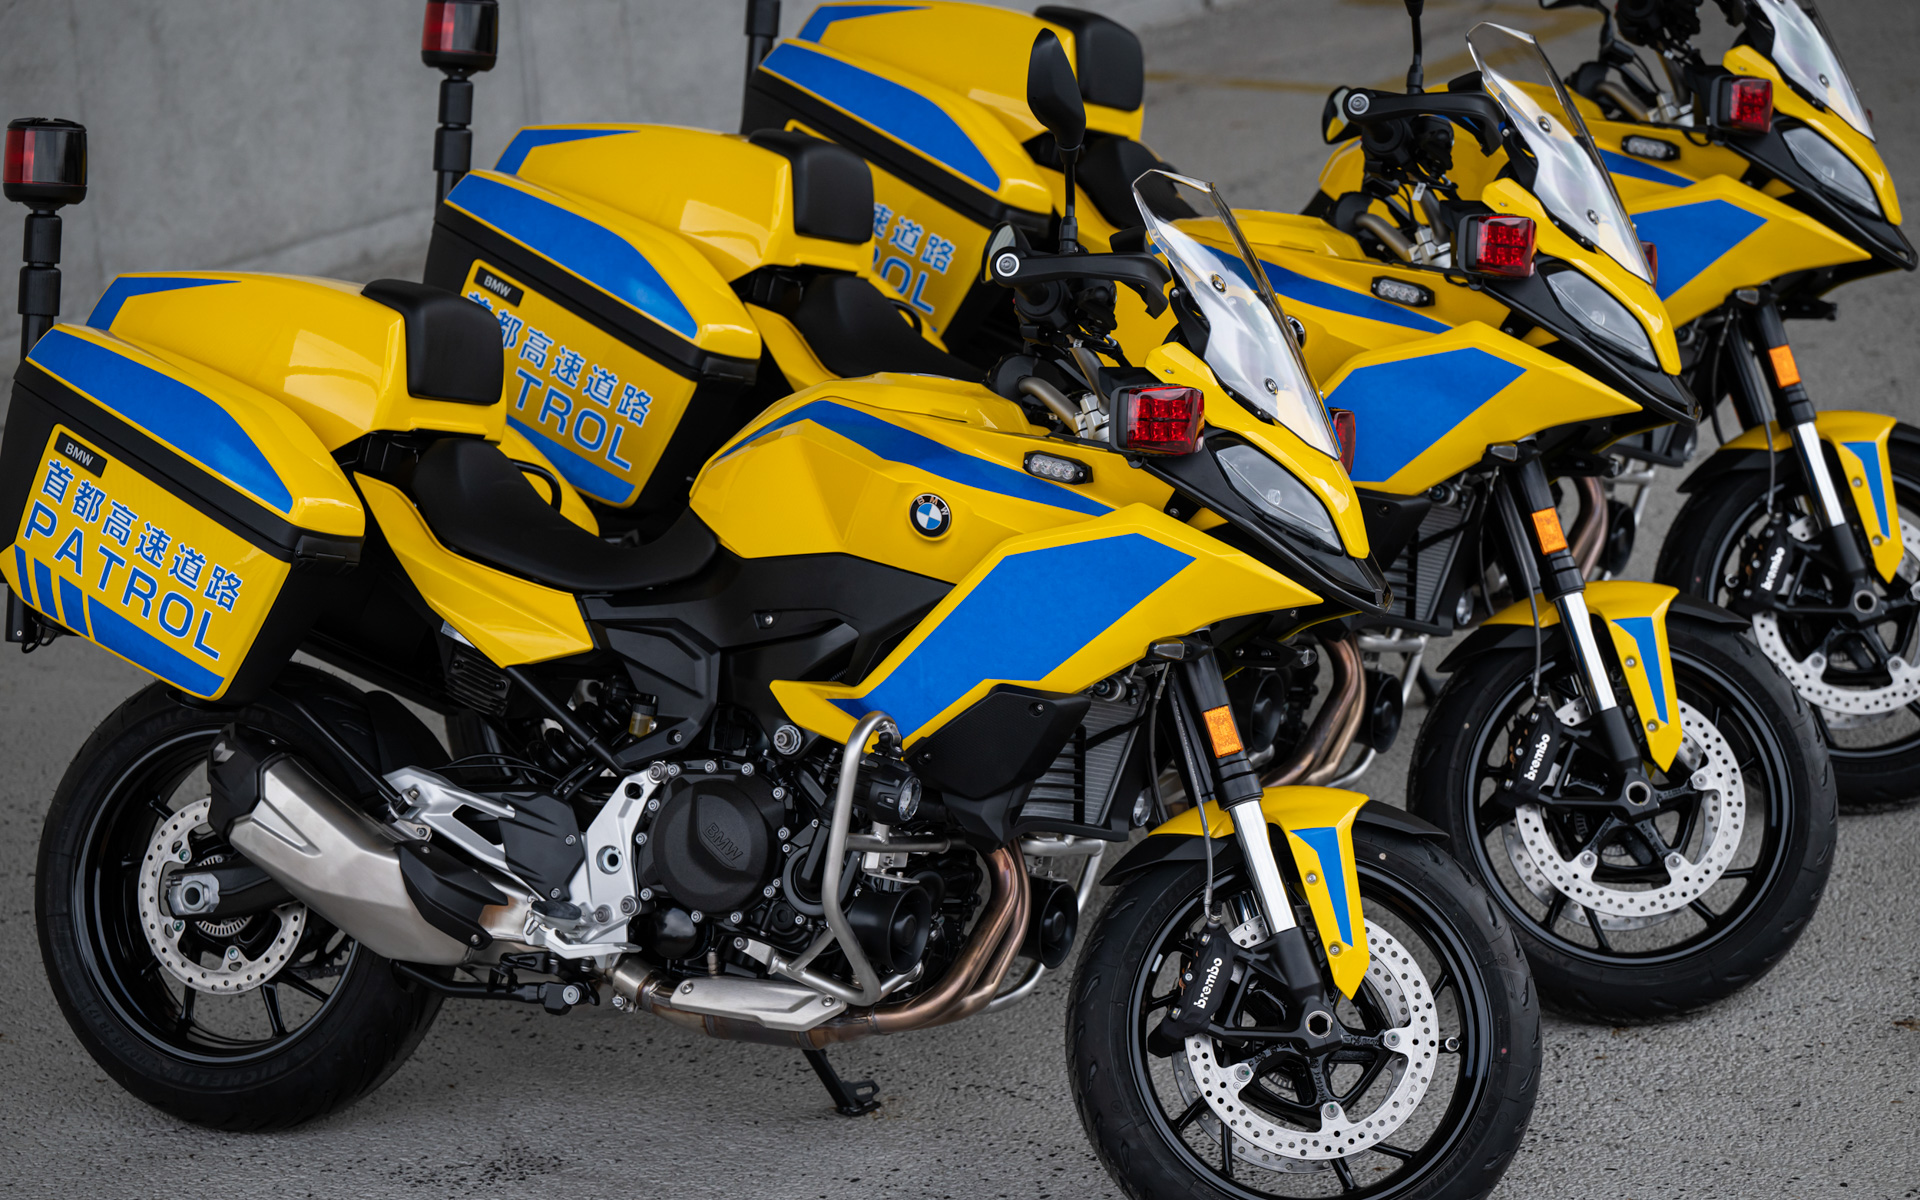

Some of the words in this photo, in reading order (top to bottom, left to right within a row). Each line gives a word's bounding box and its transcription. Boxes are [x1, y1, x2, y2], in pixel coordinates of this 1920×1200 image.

[484, 275, 512, 297] BMW
[515, 366, 632, 473] TROL
[65, 442, 94, 467] BMW
[917, 496, 949, 515] BMW
[42, 459, 243, 613] 首都高速道路
[23, 499, 220, 661] PATROL
[1760, 546, 1786, 591] brembo
[1523, 733, 1551, 781] brembo
[705, 822, 744, 861] BMW
[1193, 957, 1223, 1009] brembo
